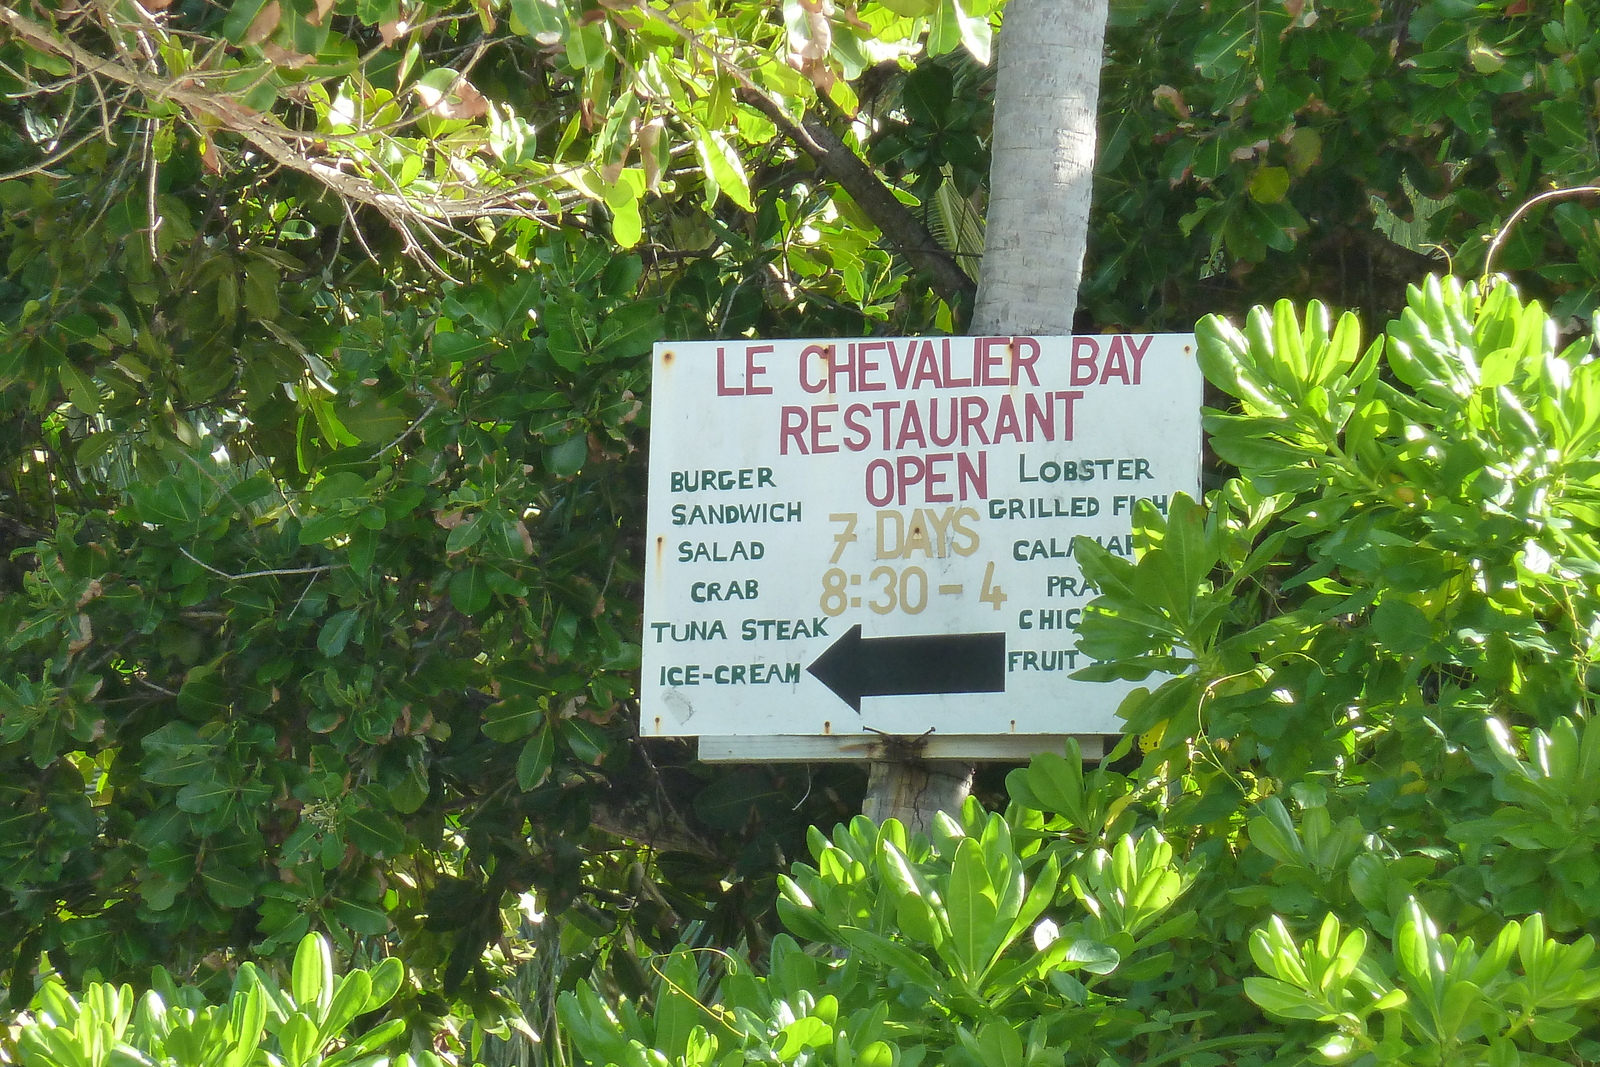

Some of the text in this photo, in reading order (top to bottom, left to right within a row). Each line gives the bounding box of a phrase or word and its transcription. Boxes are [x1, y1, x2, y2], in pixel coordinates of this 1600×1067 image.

[716, 335, 1154, 396] LE CHEVALIER BAY
[780, 390, 1084, 456] RESTAURANT
[670, 467, 777, 493] BURGER
[865, 450, 988, 507] OPEN
[1019, 453, 1154, 483] LOBSTER
[671, 501, 802, 525] SANDWICH
[988, 494, 1168, 520] GRILLED FIH
[828, 506, 981, 564] 7 DAYS
[678, 541, 765, 563] SALAD
[690, 579, 759, 603] CRAB
[819, 565, 928, 617] 8:30
[979, 560, 1008, 611] 4
[1047, 575, 1106, 598] PRA
[650, 616, 829, 643] TUNA STEAK
[1019, 608, 1081, 630] CHIC
[1008, 650, 1079, 672] FRUIT
[659, 662, 801, 687] ICE-CREAM
